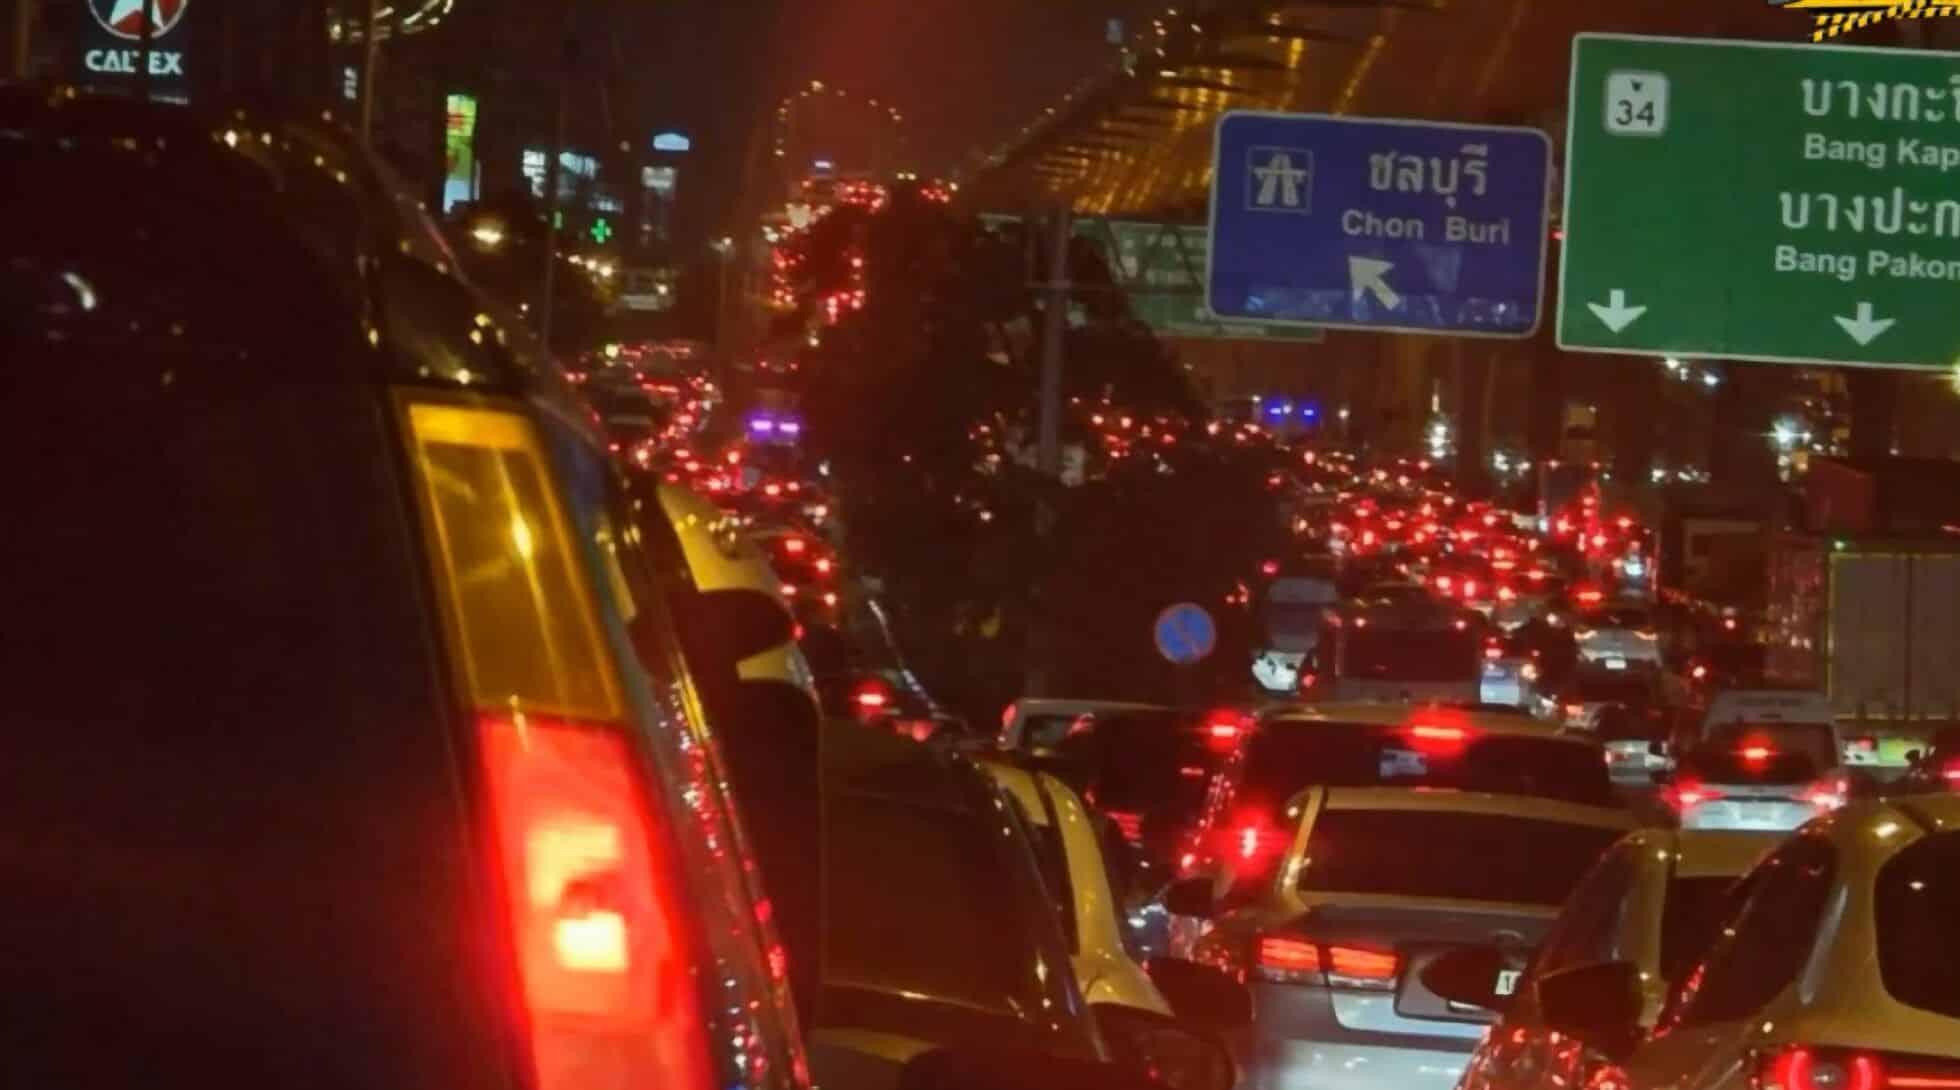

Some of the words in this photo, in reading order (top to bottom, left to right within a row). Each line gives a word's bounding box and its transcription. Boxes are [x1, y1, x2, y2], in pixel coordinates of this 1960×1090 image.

[1615, 99, 1655, 126] 34
[1804, 133, 1886, 169] Bang
[1897, 137, 1960, 172] Kap
[1369, 143, 1489, 208] ชลบุรี
[1342, 208, 1424, 239] Chon
[1445, 215, 1511, 245] Buri
[1779, 186, 1960, 237] บางปะก
[1775, 245, 1856, 282] Bang
[1868, 250, 1960, 280] Pakon
